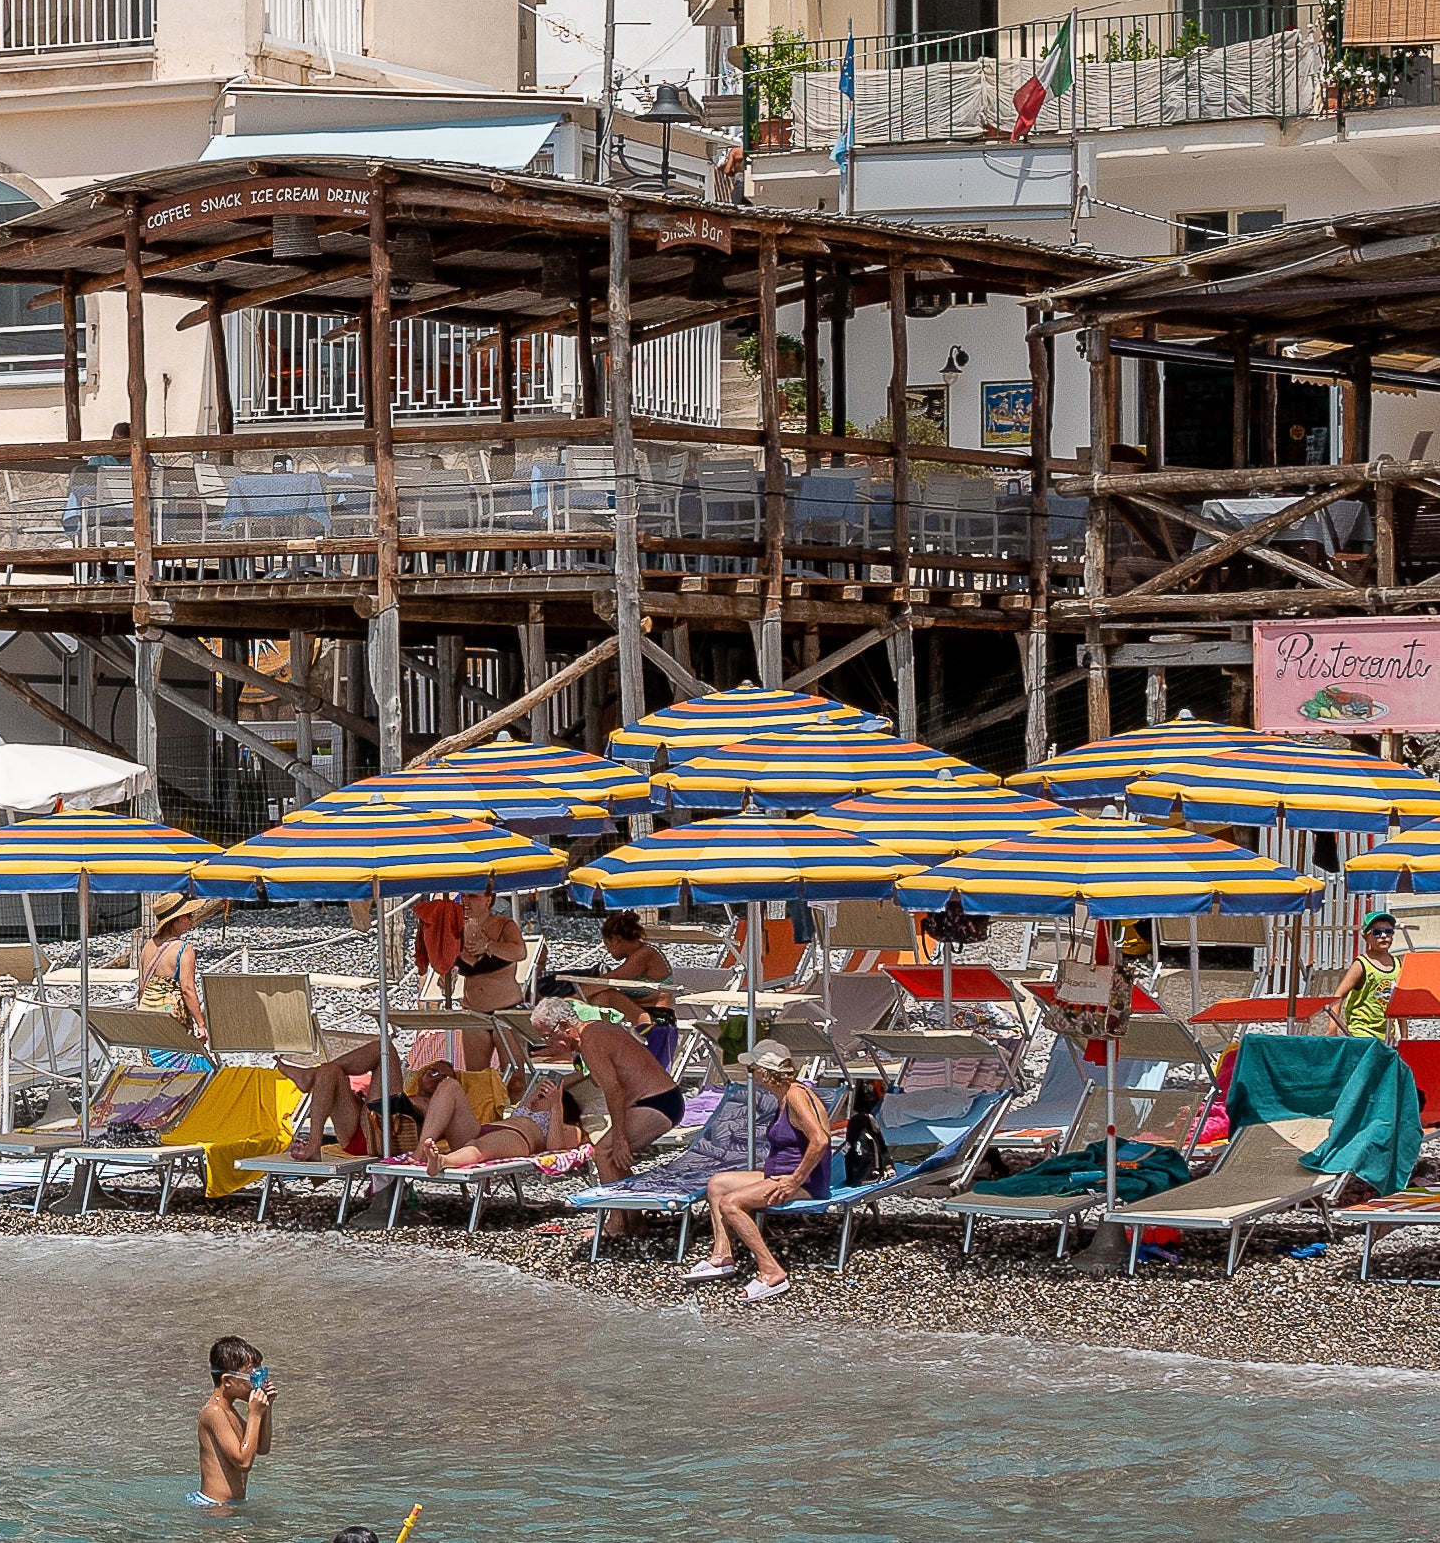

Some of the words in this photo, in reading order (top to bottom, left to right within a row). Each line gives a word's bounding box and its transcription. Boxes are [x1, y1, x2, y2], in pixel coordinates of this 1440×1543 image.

[147, 203, 191, 229] COFFEE
[200, 192, 243, 213] SNACK
[250, 188, 273, 205] ICE
[276, 187, 319, 202] CREAM
[701, 218, 723, 243] Bar
[1276, 631, 1433, 680] Ristorante
